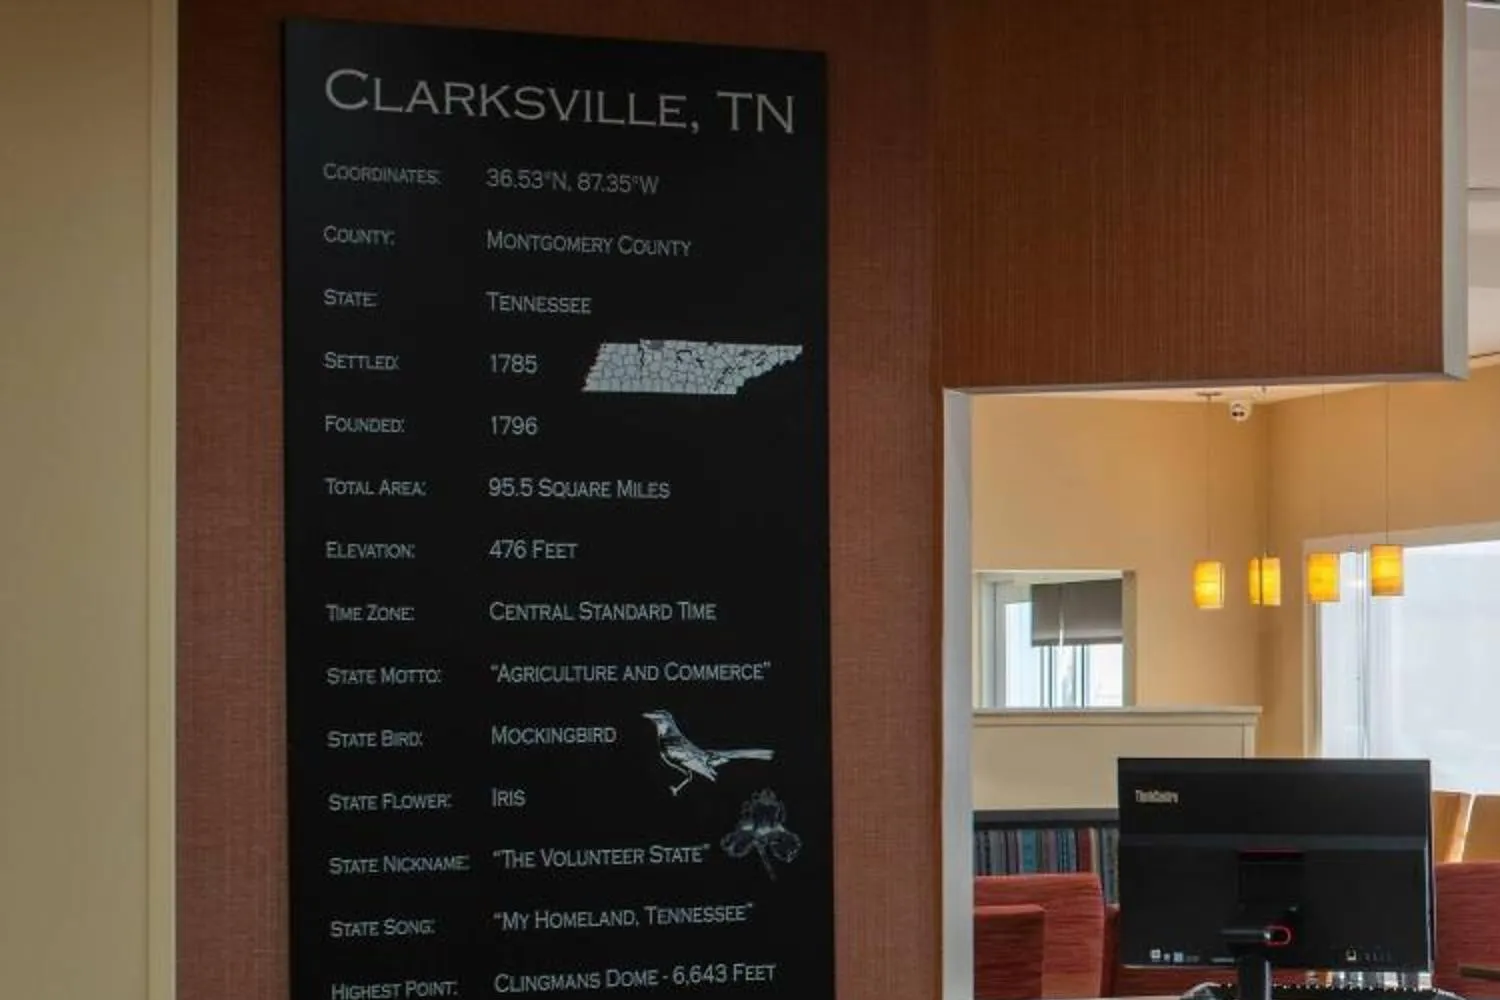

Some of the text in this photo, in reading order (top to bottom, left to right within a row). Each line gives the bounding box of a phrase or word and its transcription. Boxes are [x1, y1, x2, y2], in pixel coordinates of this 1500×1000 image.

[325, 69, 795, 134] CLARKSVILLE, TN
[577, 172, 659, 195] 87.35°W
[323, 225, 395, 246] COUNTY:
[487, 230, 692, 257] MONTGOMERY COUNTY
[486, 291, 592, 315] TENNESSEE
[490, 354, 537, 375] 1785
[325, 415, 405, 433] FOUNDED:
[490, 416, 538, 436] 1796
[324, 478, 426, 496] TOTAL AREA:
[489, 478, 671, 500] 95.5 SQUARE MILES
[325, 541, 416, 559] ELEVATION:
[490, 540, 578, 559] 476 FEET
[325, 604, 415, 622] TIME ZONE:
[490, 602, 717, 621] CENTRAL STANDARD TIME
[326, 667, 442, 685] STATE MOTTO:
[623, 664, 659, 682] AND
[327, 730, 423, 748] STATE BIRD:
[491, 726, 617, 746] MOCKINGBIRD
[328, 792, 453, 811] STATE FLOWER:
[492, 788, 526, 808] IRIS
[328, 857, 379, 875] STATE
[540, 848, 645, 867] VOLUNTEER
[534, 909, 639, 929] HOMELAND,
[330, 921, 379, 937] STATE
[494, 972, 600, 993] CLINGMANS
[605, 970, 659, 989] DOME
[672, 964, 727, 985] 6,643
[732, 963, 776, 982] FEET
[331, 984, 402, 1000] HIGHEST
